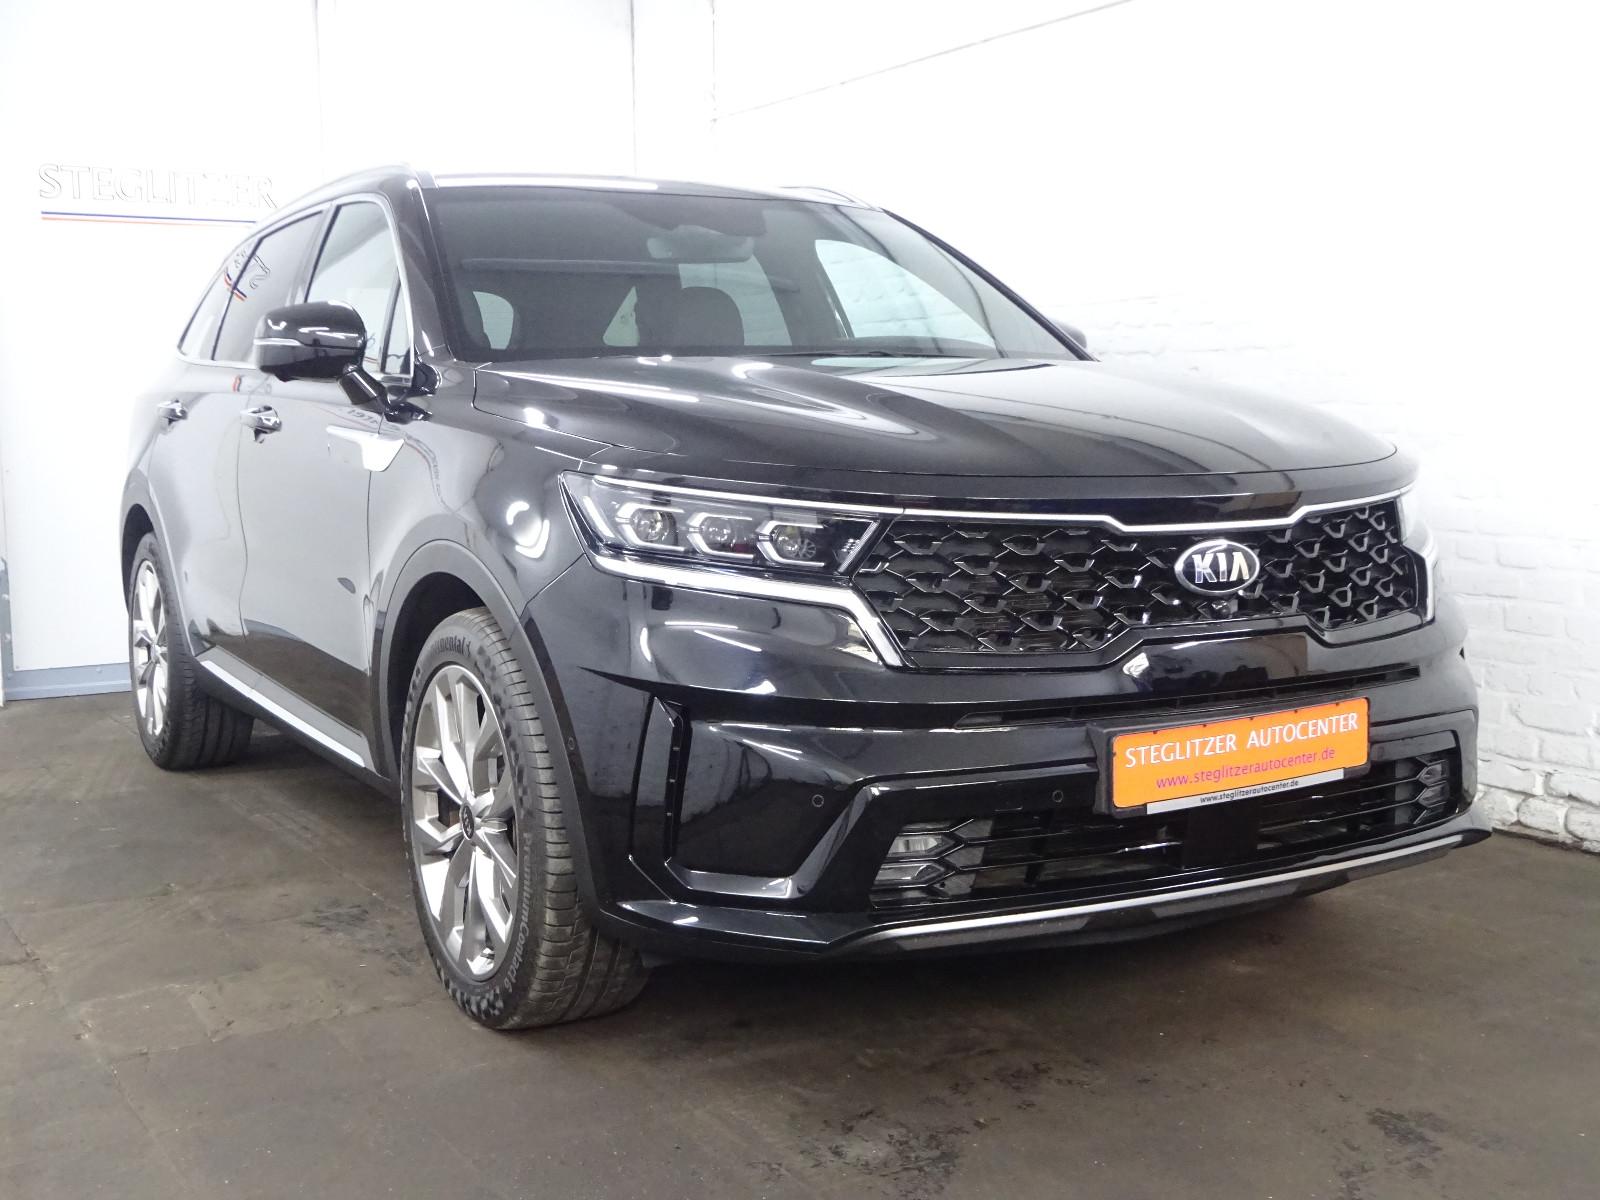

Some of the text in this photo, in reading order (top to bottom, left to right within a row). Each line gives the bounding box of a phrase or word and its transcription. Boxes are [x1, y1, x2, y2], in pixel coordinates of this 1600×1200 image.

[1192, 551, 1250, 583] KIA
[1125, 713, 1358, 768] STEGLITZER AUTOCENTER
[1156, 747, 1335, 789] www.steglitzerautocenter.de
[1200, 780, 1299, 803] www.steglitzerautocenter.de
